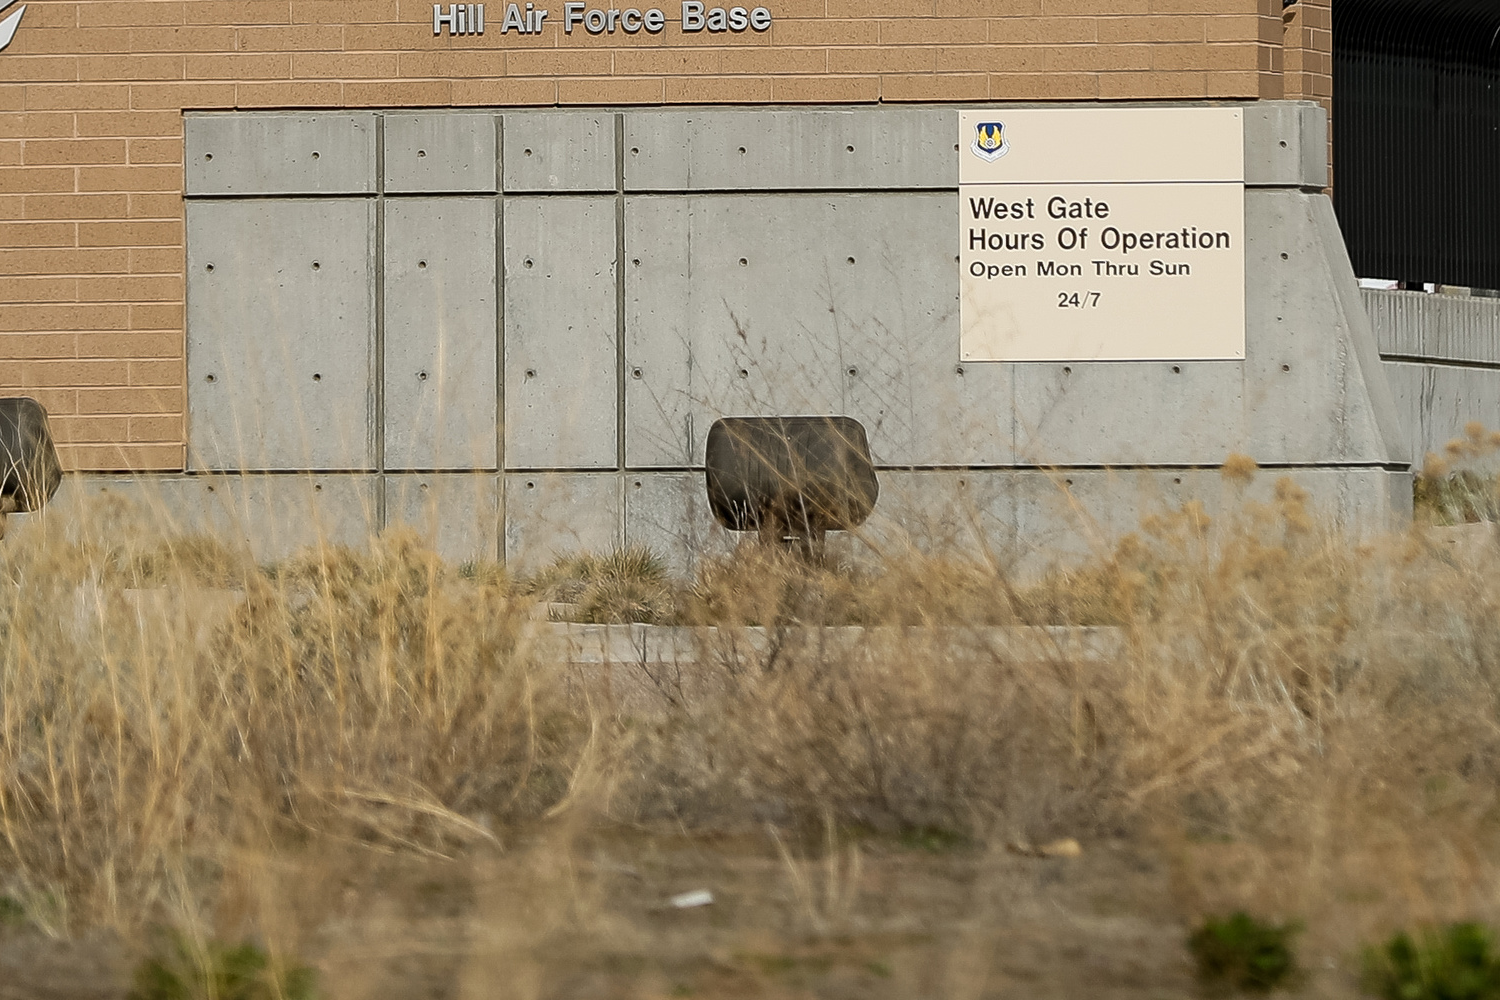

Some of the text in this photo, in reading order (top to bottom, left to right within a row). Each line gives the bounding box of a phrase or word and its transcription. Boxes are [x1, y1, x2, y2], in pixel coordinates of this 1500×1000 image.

[433, 1, 771, 34] Hill Air Force Base
[969, 196, 1110, 219] West Gate
[969, 226, 1230, 254] Hours Of Operation
[969, 260, 1190, 279] Open Mon Thru Sun
[1058, 291, 1101, 309] 24/7
